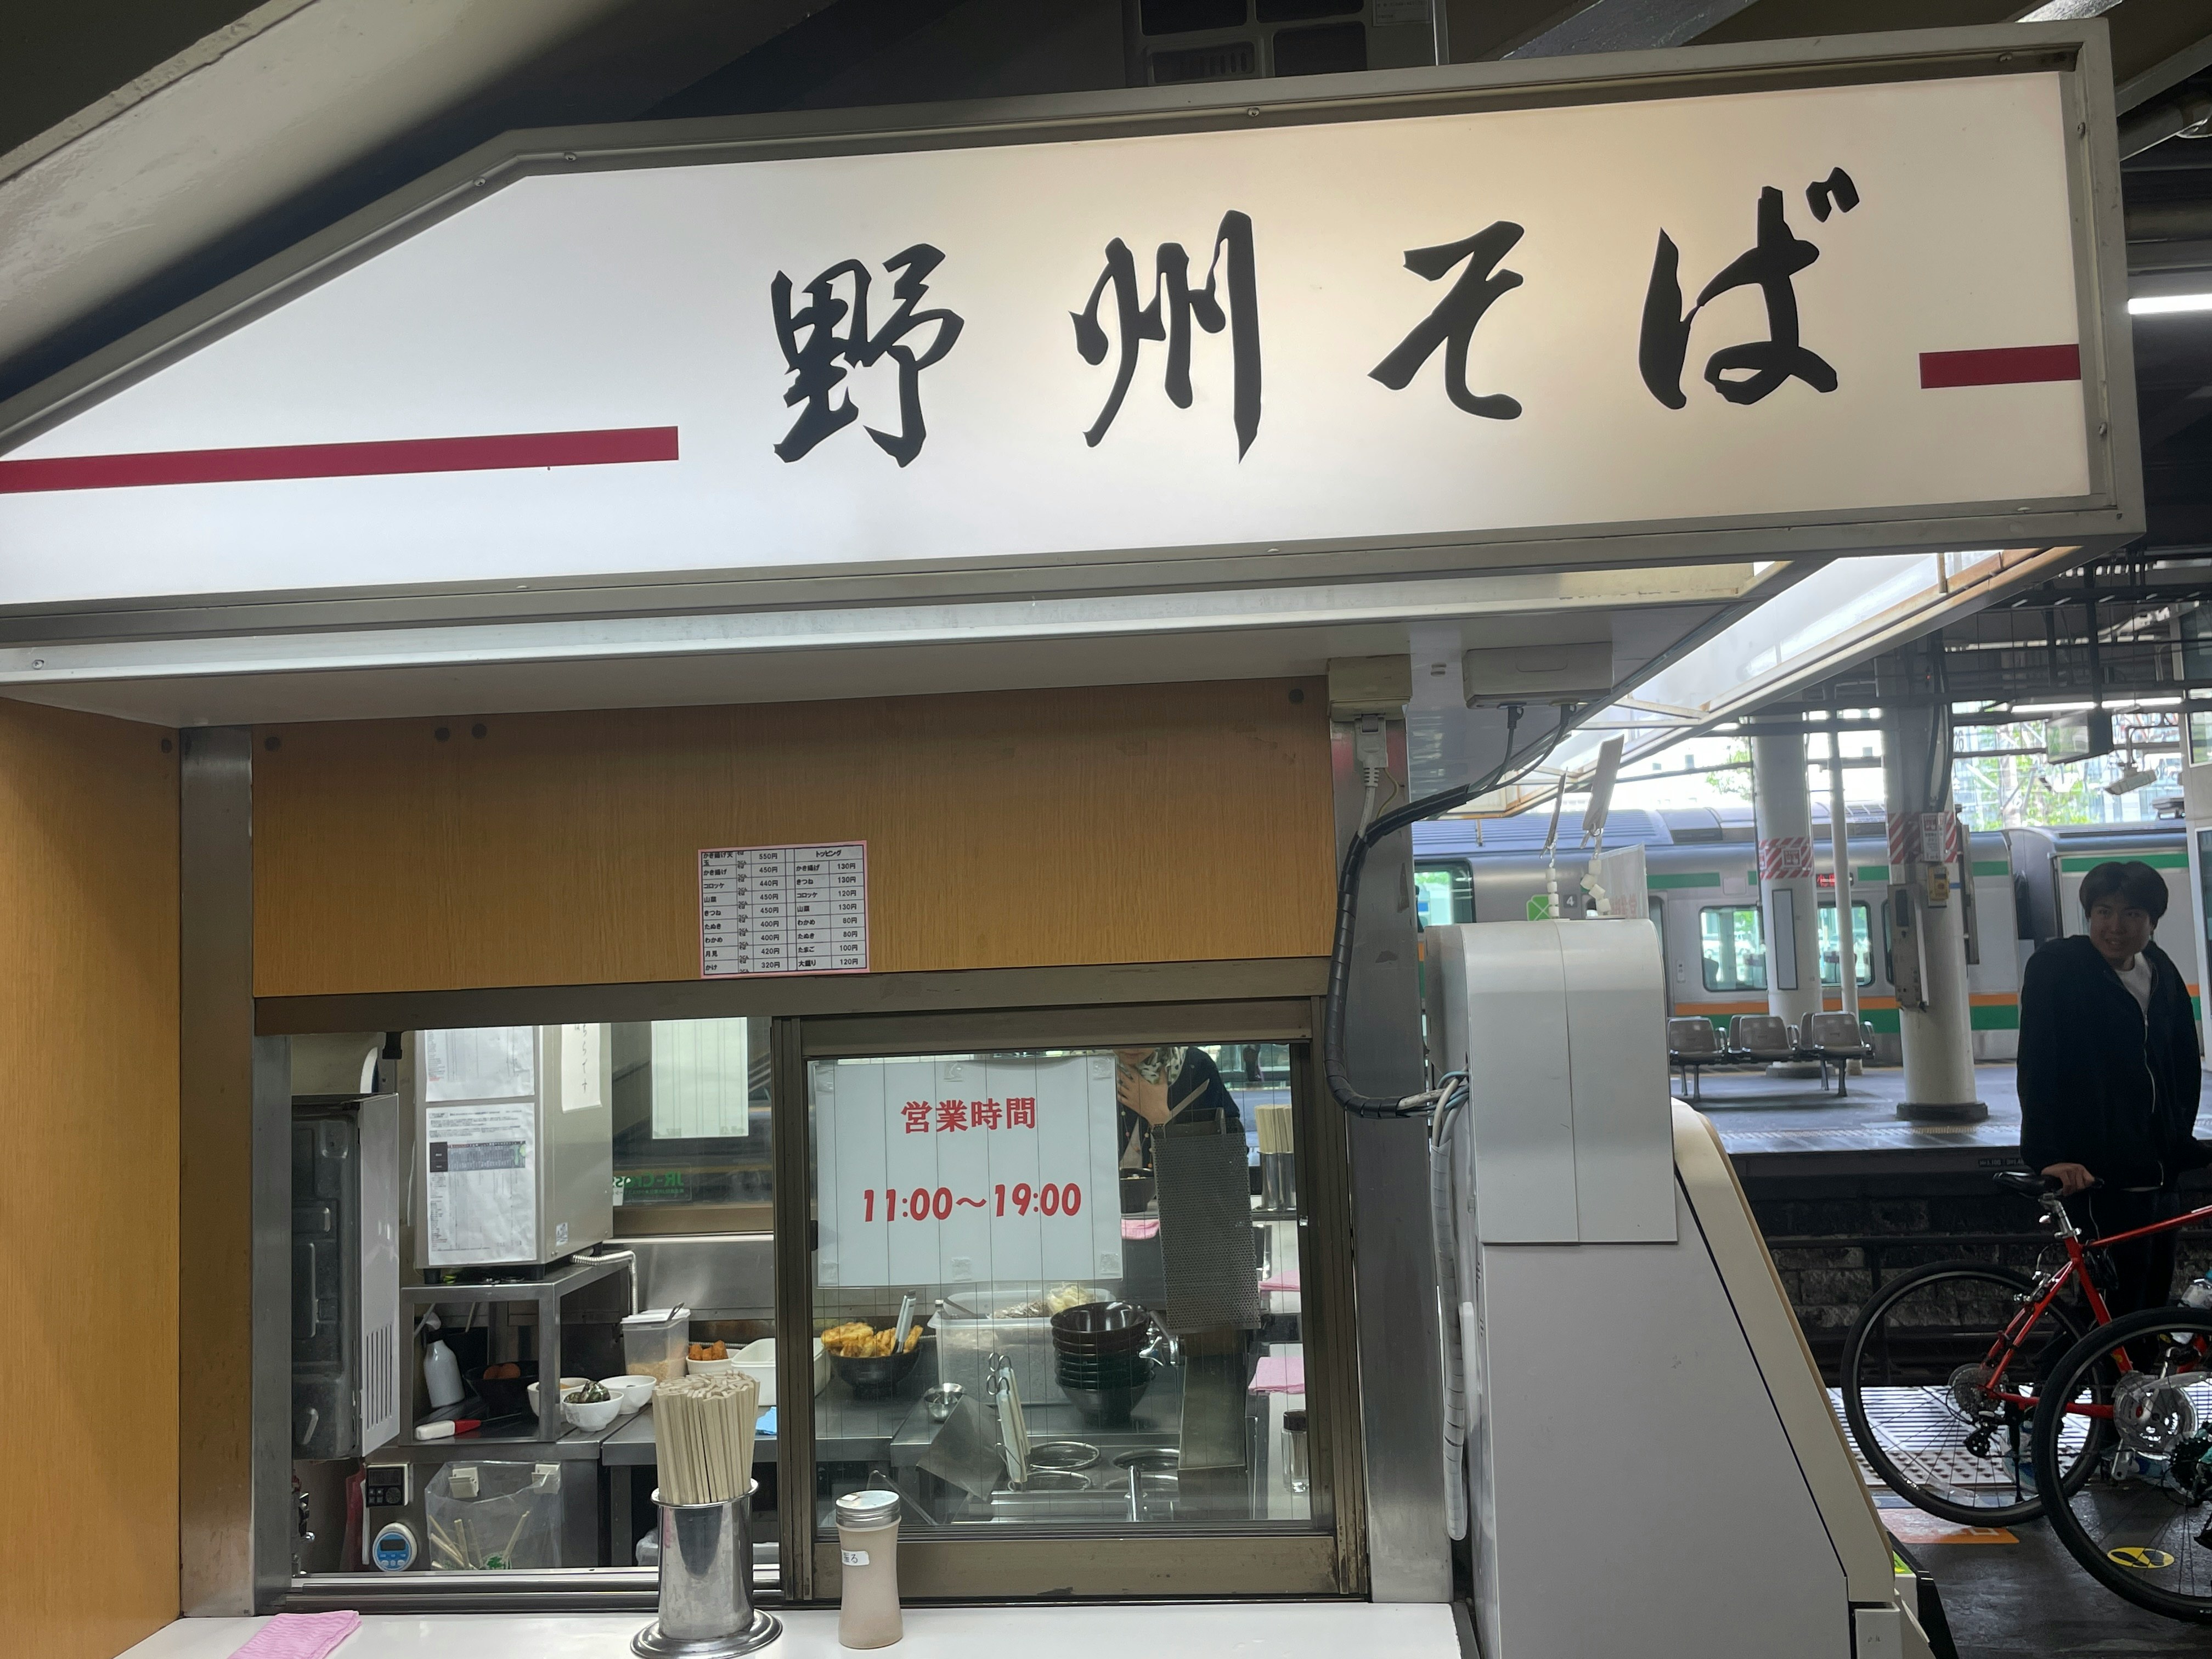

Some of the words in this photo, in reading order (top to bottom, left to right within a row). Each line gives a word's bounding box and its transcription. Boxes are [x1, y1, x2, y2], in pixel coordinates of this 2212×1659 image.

[770, 166, 1860, 468] 野州そば
[1566, 895, 1574, 906] 4
[900, 1097, 1036, 1134] 営業時間
